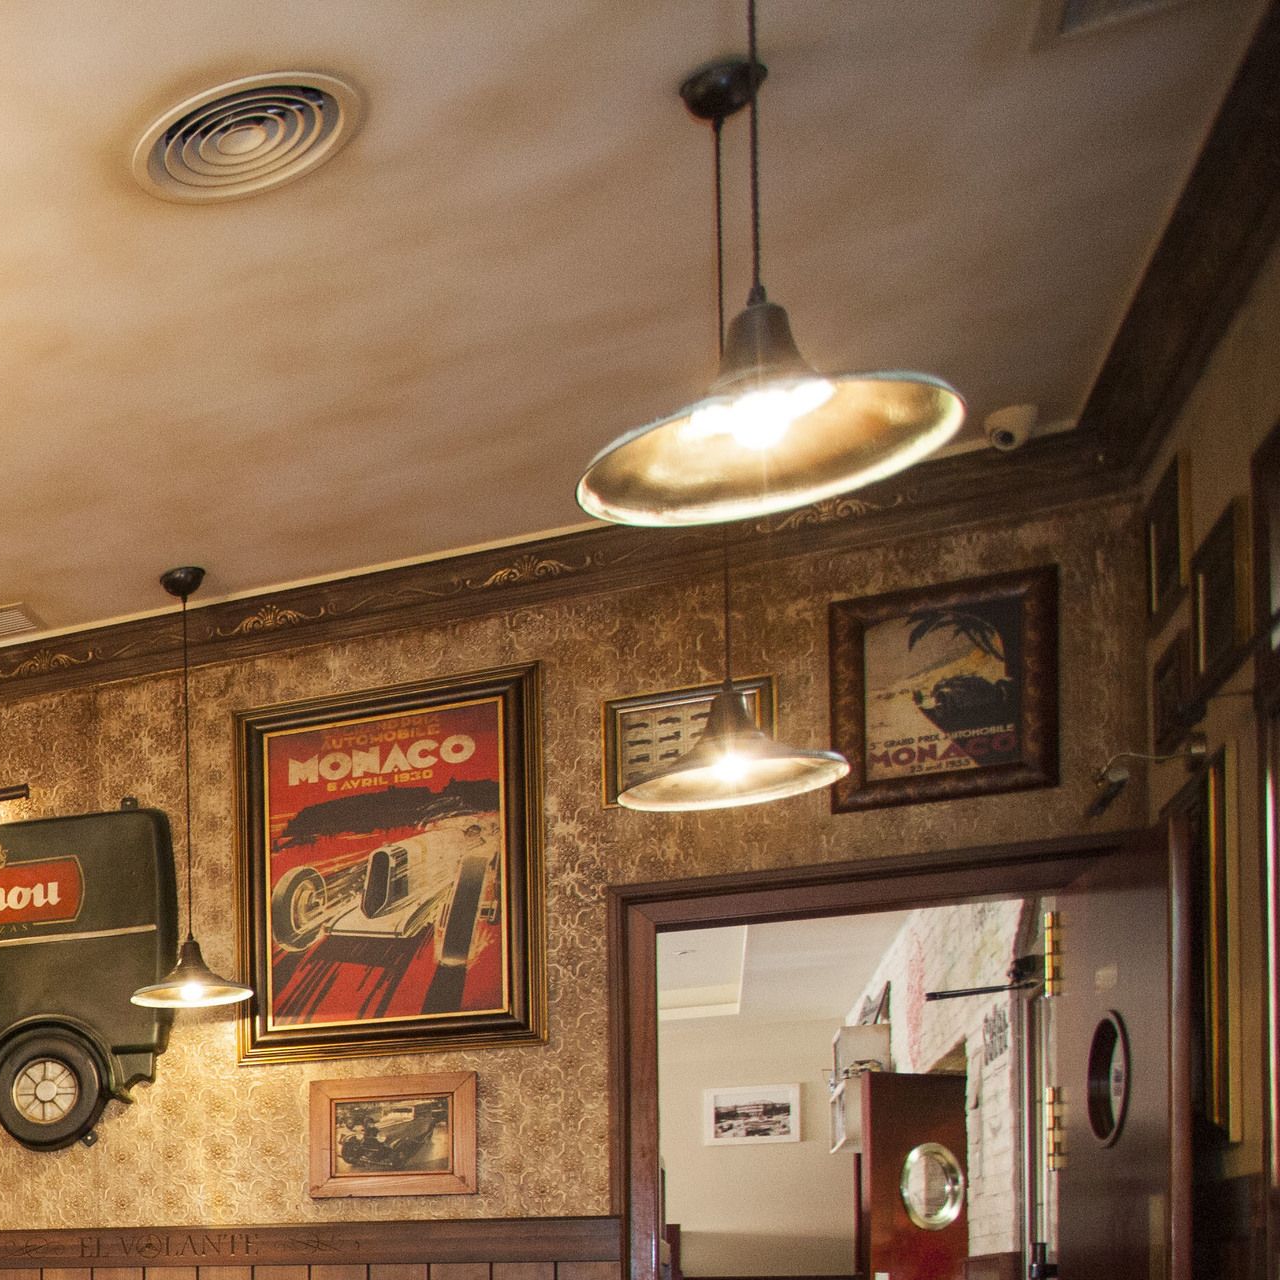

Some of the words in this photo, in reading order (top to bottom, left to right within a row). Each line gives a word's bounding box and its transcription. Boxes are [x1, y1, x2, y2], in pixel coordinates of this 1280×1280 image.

[321, 724, 440, 750] AUTOMOBILE
[884, 737, 915, 748] GRAND
[918, 733, 940, 743] PRIX
[288, 734, 476, 786] MONACO
[868, 734, 1017, 769] MONACO
[341, 776, 389, 790] AVRIL
[394, 769, 433, 783] 1930
[80, 1237, 109, 1258] EL
